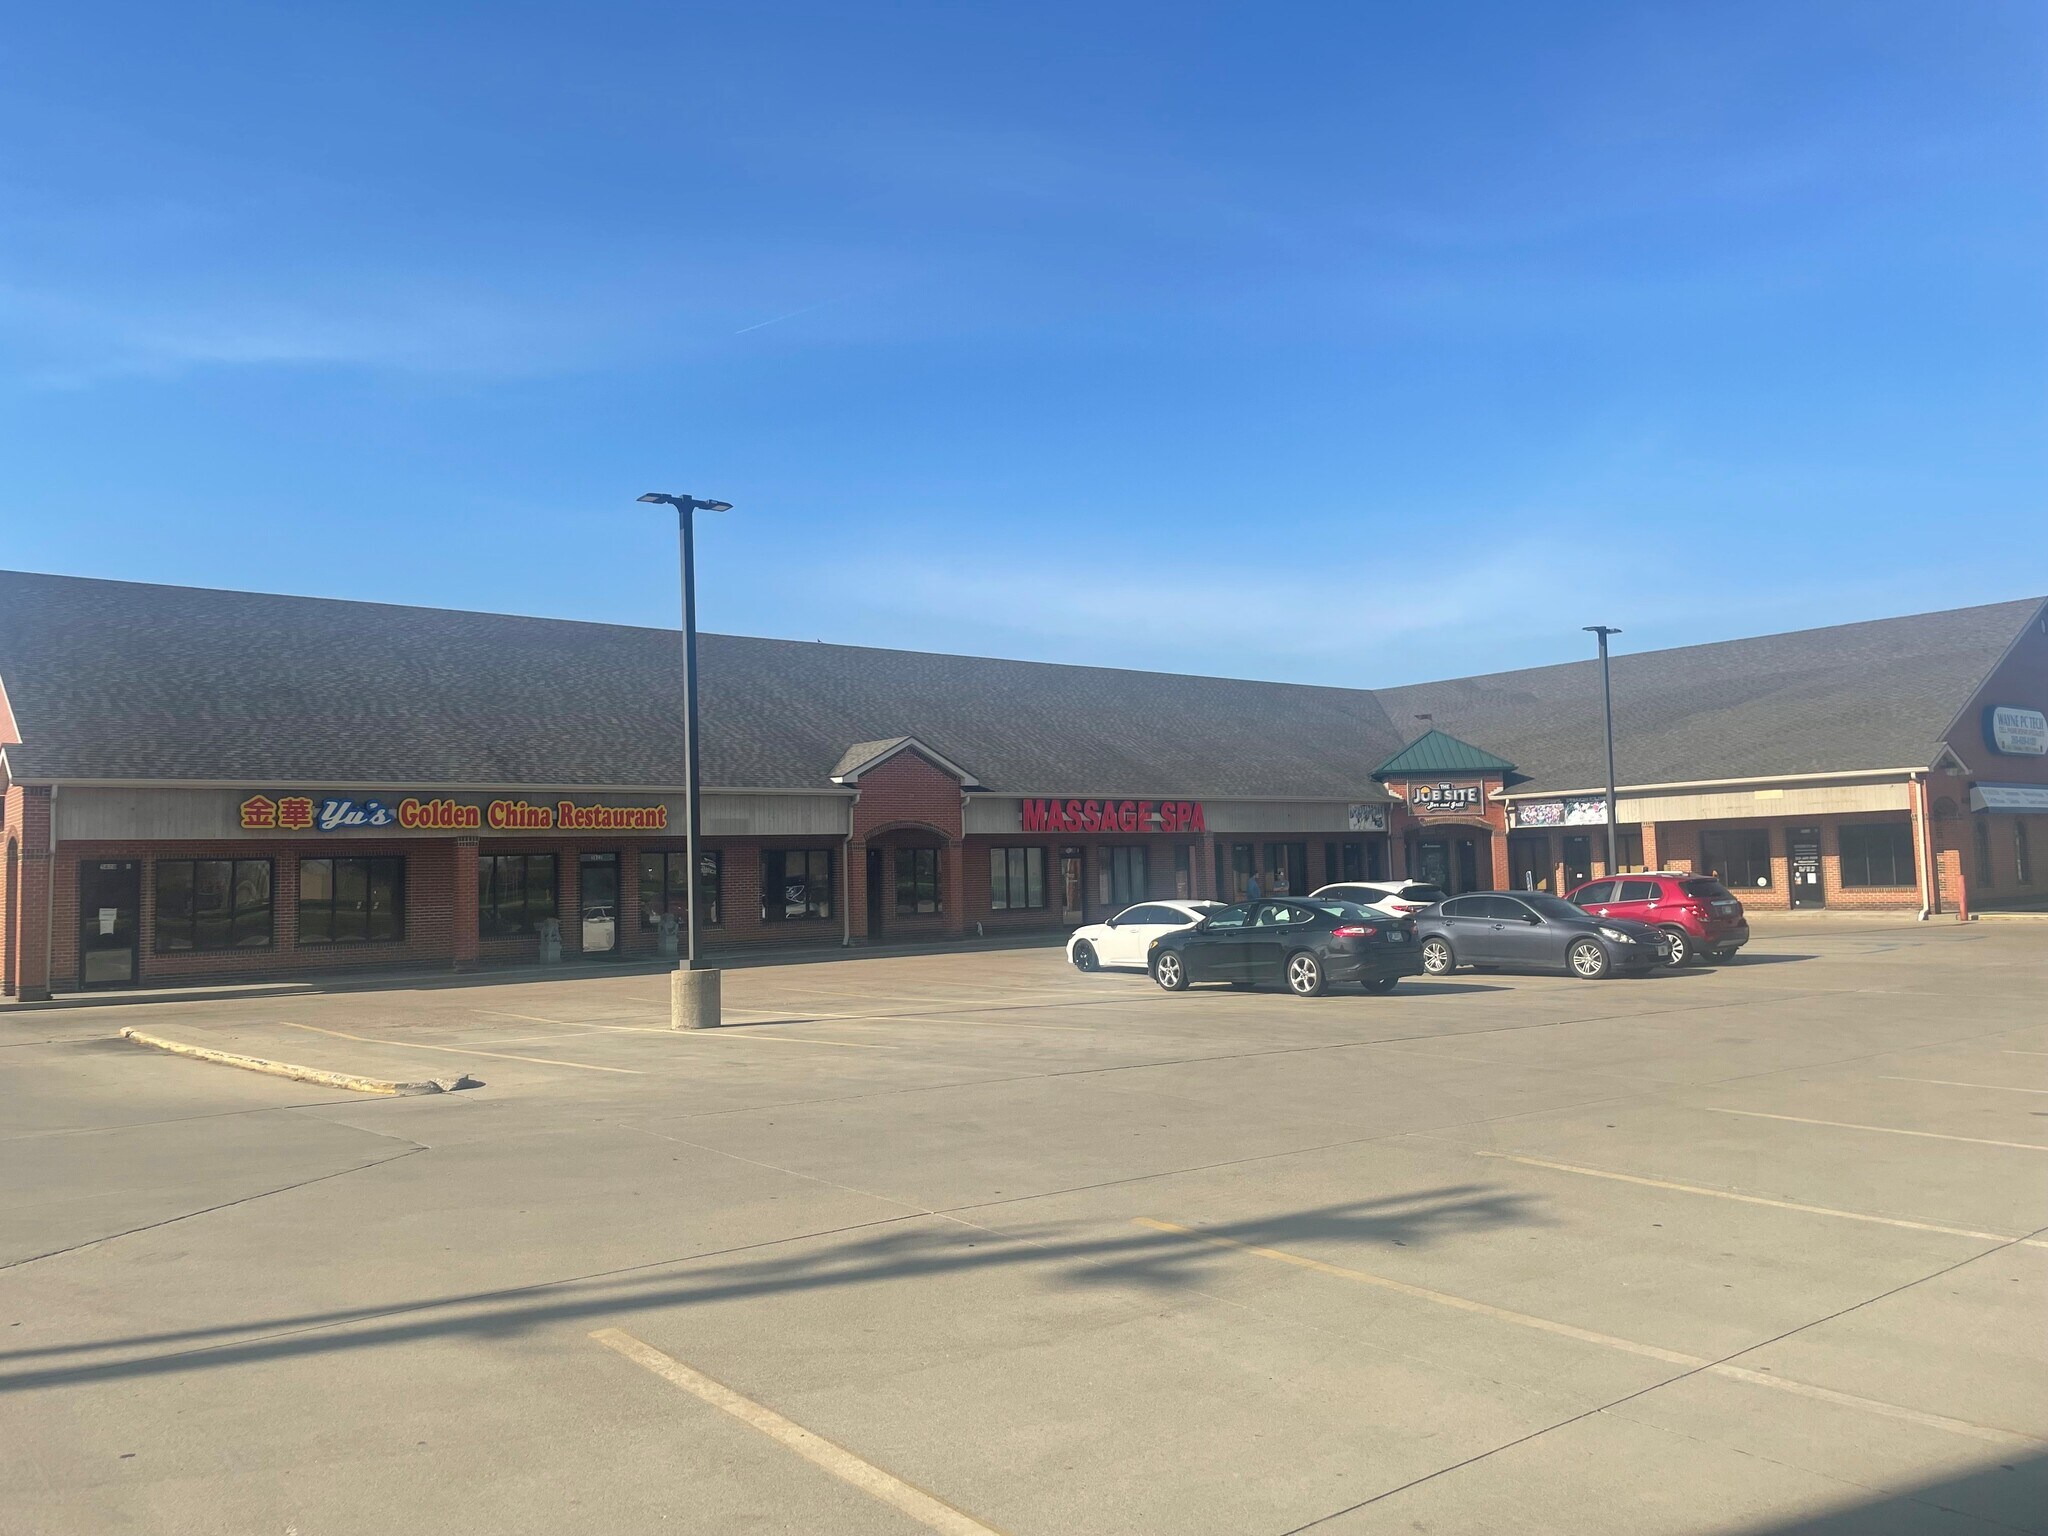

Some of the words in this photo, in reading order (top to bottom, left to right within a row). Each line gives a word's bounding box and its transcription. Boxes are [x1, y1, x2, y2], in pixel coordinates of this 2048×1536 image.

[1997, 713, 2019, 727] WAYNE
[2029, 716, 2044, 730] TECH
[1413, 786, 1442, 803] JOB
[1444, 787, 1478, 803] SITE
[242, 796, 312, 828] 金華
[320, 800, 393, 830] Yu's
[401, 800, 480, 828] Golden
[489, 802, 553, 828] China
[557, 802, 667, 829] Restaurant
[1022, 798, 1153, 832] MASSAGE
[1160, 801, 1206, 833] SPA
